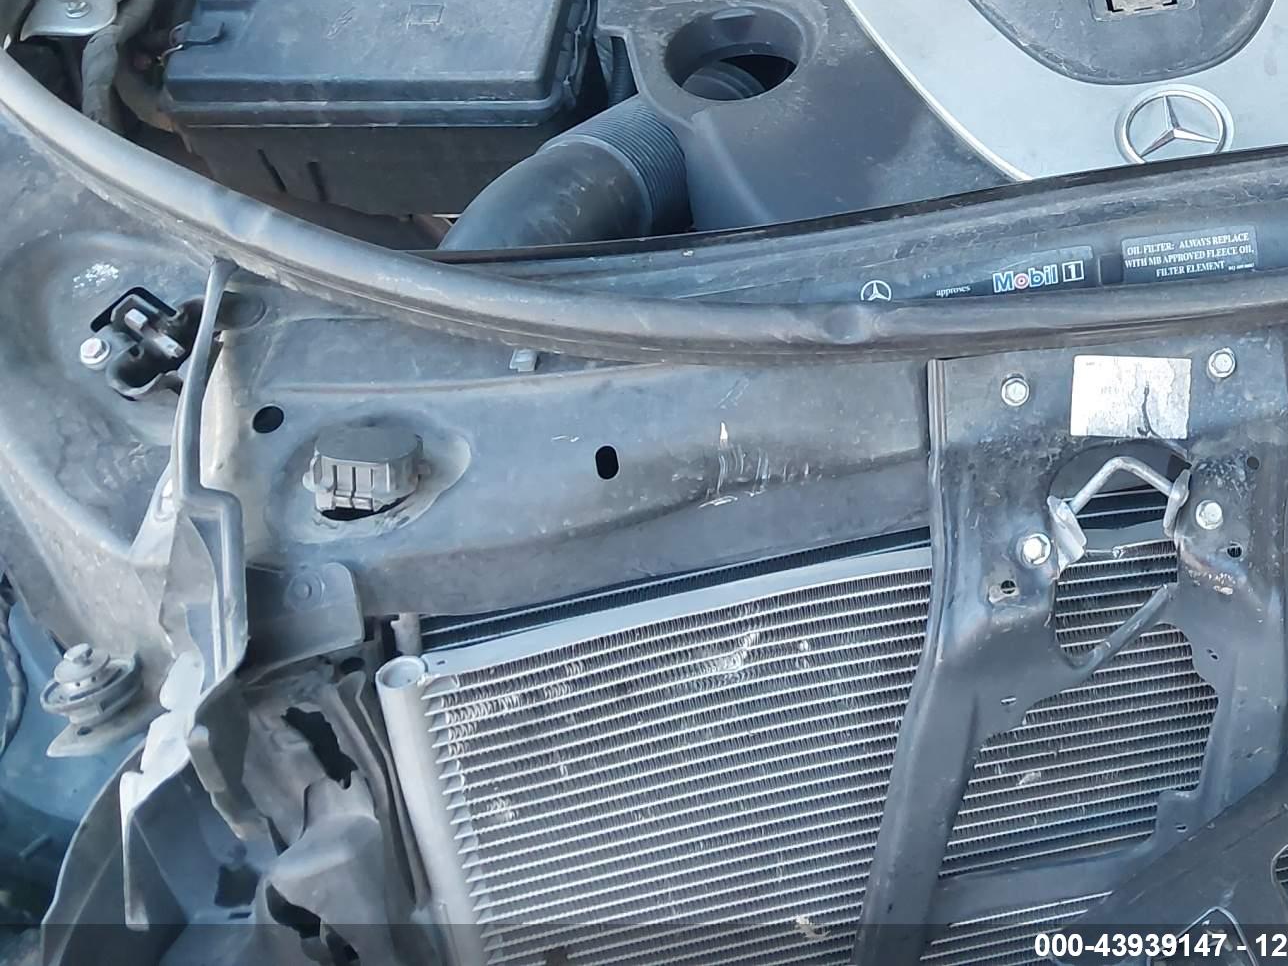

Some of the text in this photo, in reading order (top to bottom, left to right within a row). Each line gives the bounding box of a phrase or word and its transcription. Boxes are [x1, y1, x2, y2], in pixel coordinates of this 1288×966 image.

[1127, 232, 1249, 256] OIL FILTER: ALWAYS REPLACE
[1124, 258, 1148, 268] WITH
[1148, 256, 1162, 266] MB
[1162, 250, 1206, 264] APPROVED
[1206, 246, 1238, 258] FLEECE
[1156, 266, 1185, 277] FILTER
[1186, 260, 1225, 274] ELEMENT
[992, 264, 1058, 293] Mobil
